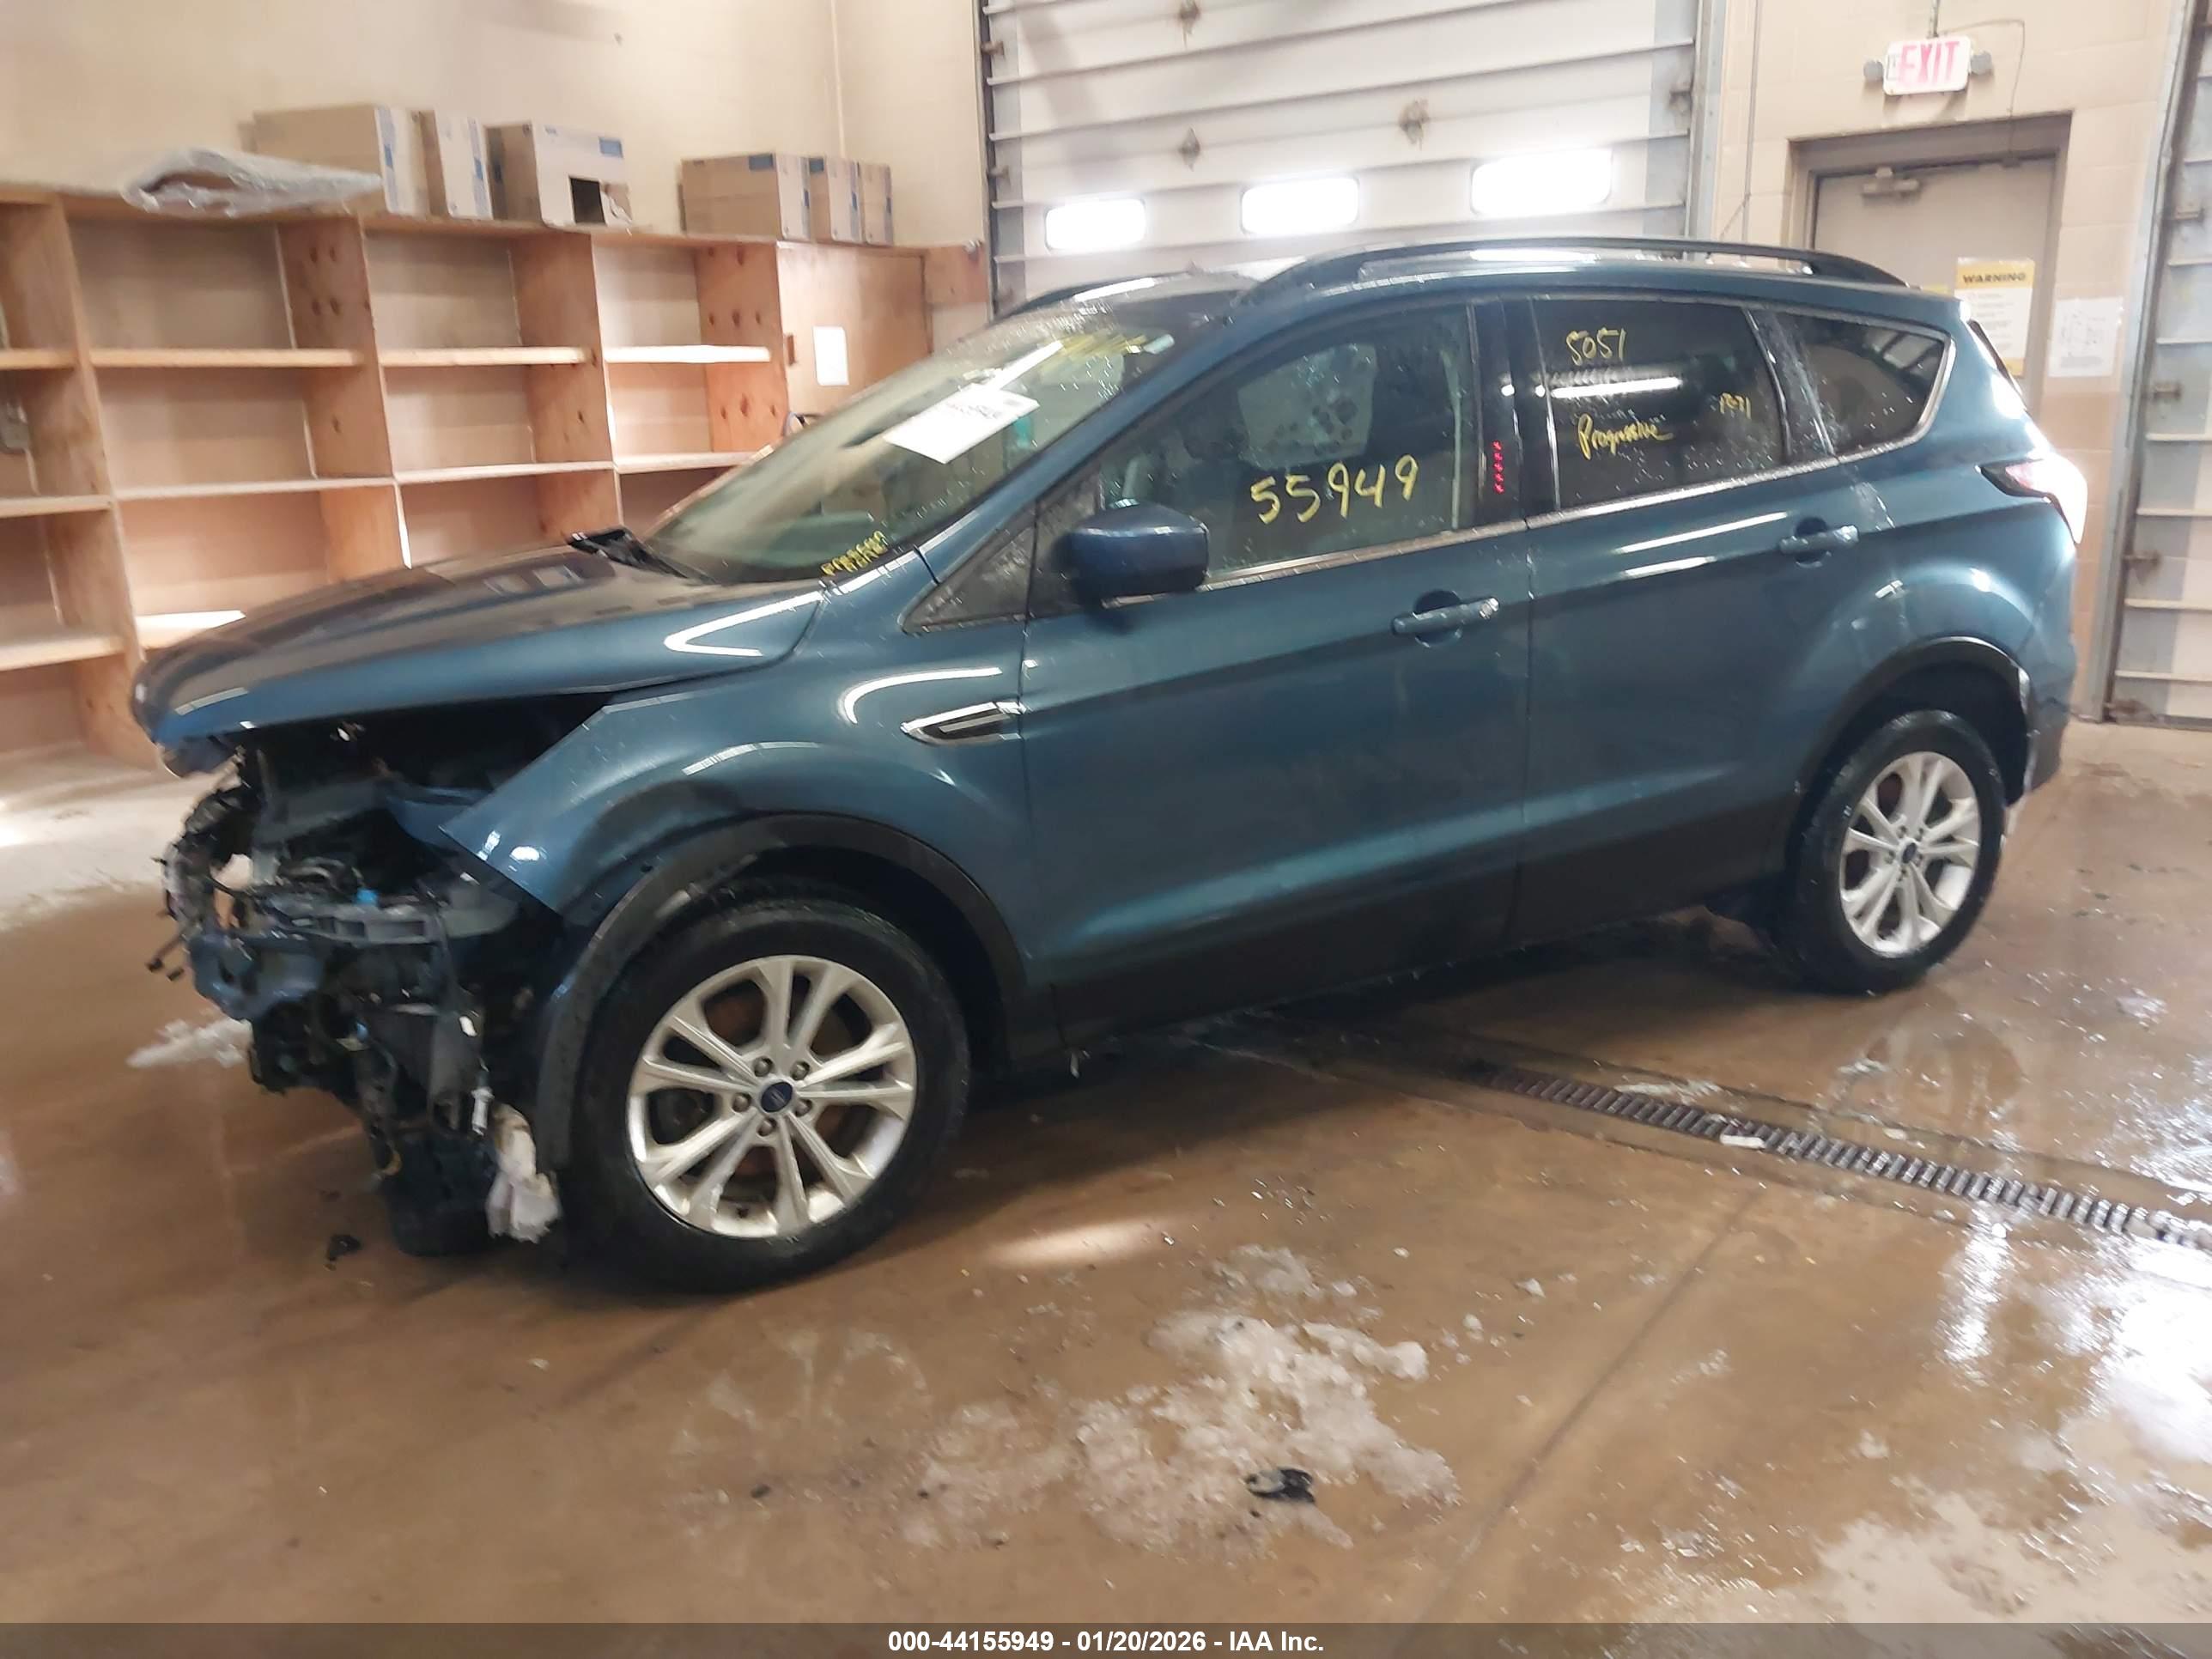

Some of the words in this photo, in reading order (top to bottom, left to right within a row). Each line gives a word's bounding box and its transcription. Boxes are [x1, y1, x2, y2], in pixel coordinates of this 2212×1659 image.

[1899, 40, 1960, 85] EXIT
[1962, 271, 2027, 284] WARNING
[1250, 454, 1419, 524] 55949
